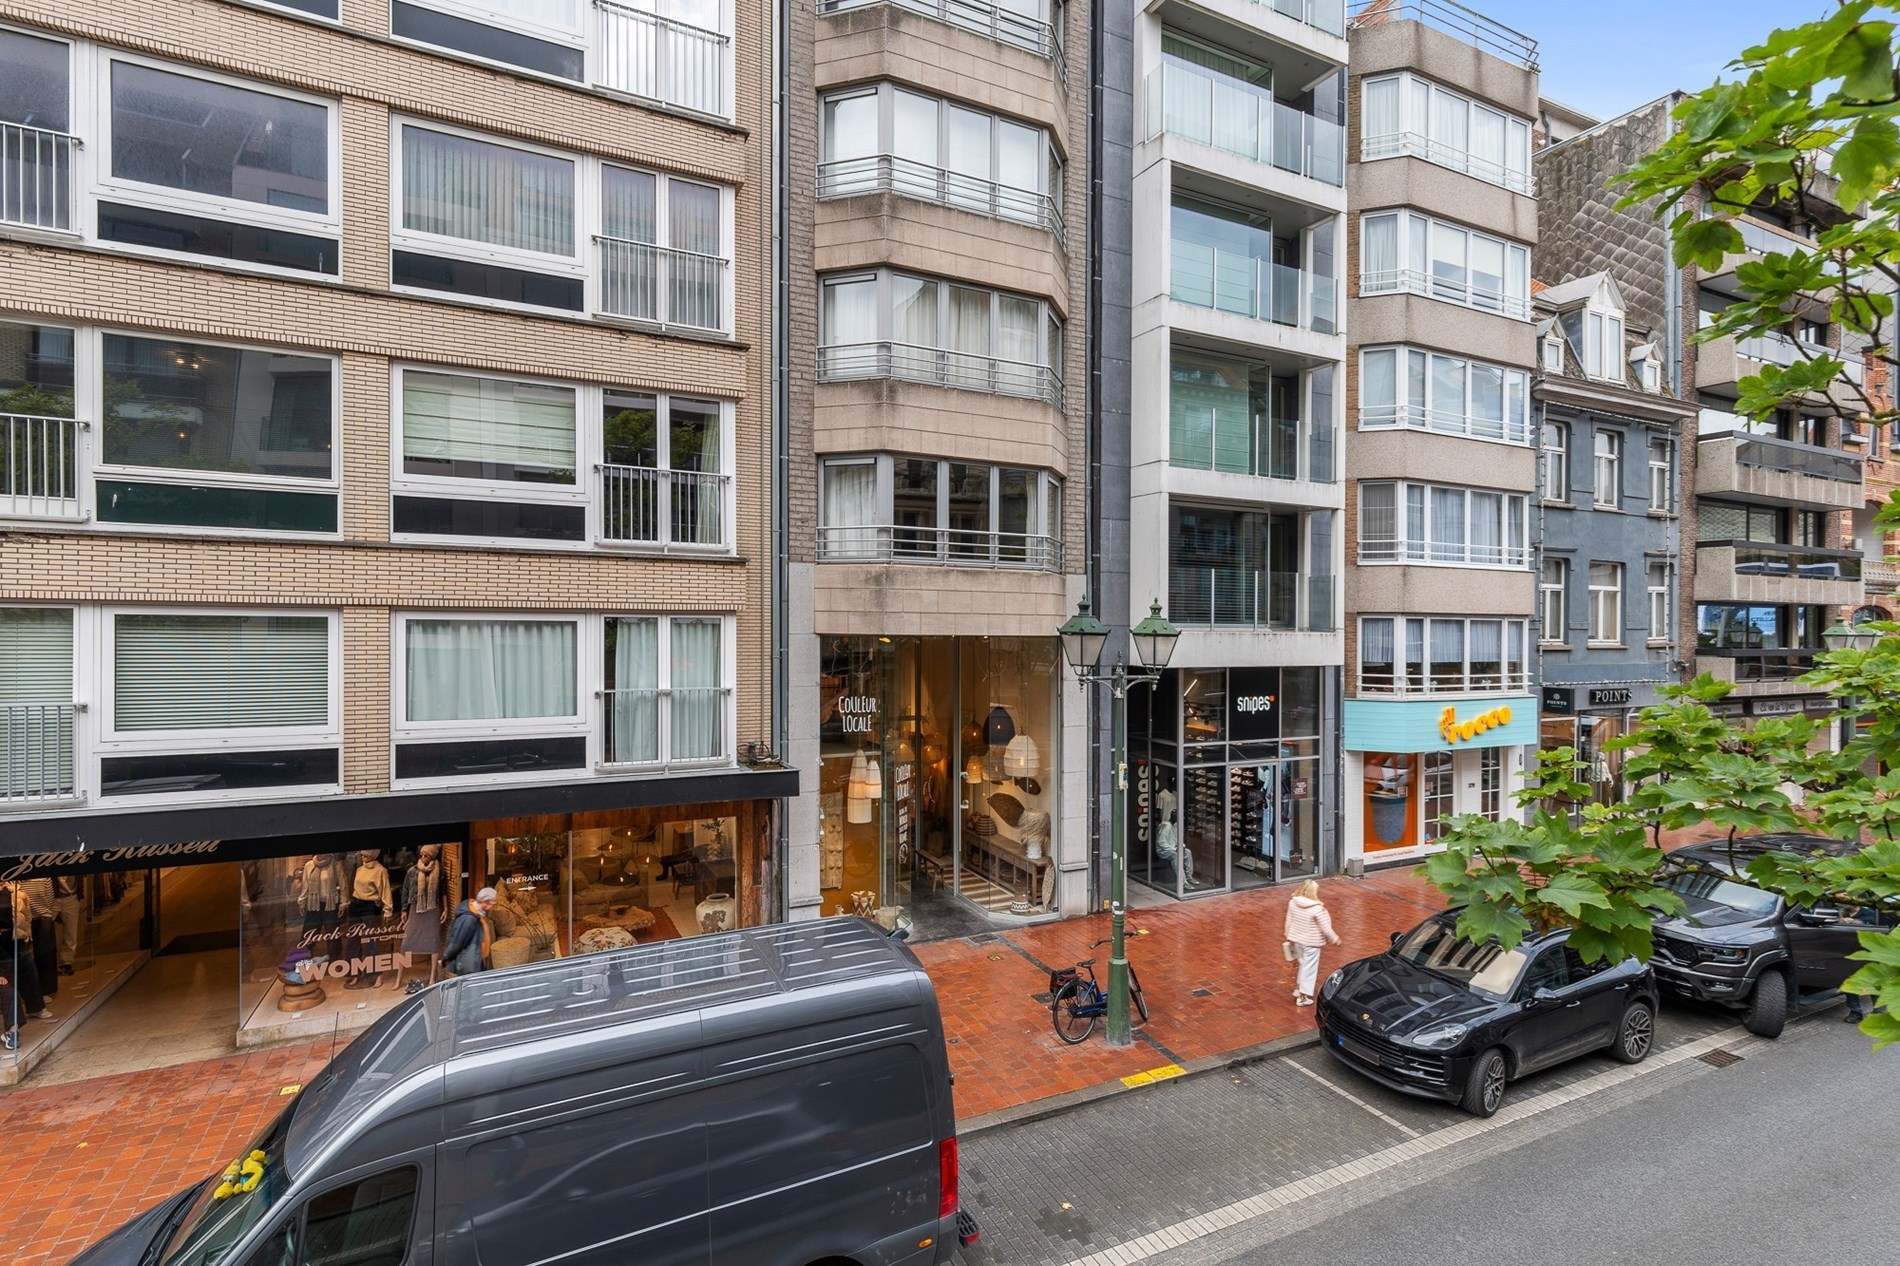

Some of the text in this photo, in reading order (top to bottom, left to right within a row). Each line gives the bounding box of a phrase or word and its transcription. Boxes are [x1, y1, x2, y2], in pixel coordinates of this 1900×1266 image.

[838, 695, 877, 713] COULEUR
[1237, 695, 1271, 715] snipes
[1595, 690, 1632, 703] POINTS
[843, 714, 872, 732] LOCALE
[506, 873, 549, 884] ENTRANCE
[297, 920, 407, 949] Jack Russell
[299, 951, 412, 982] WOMEN
